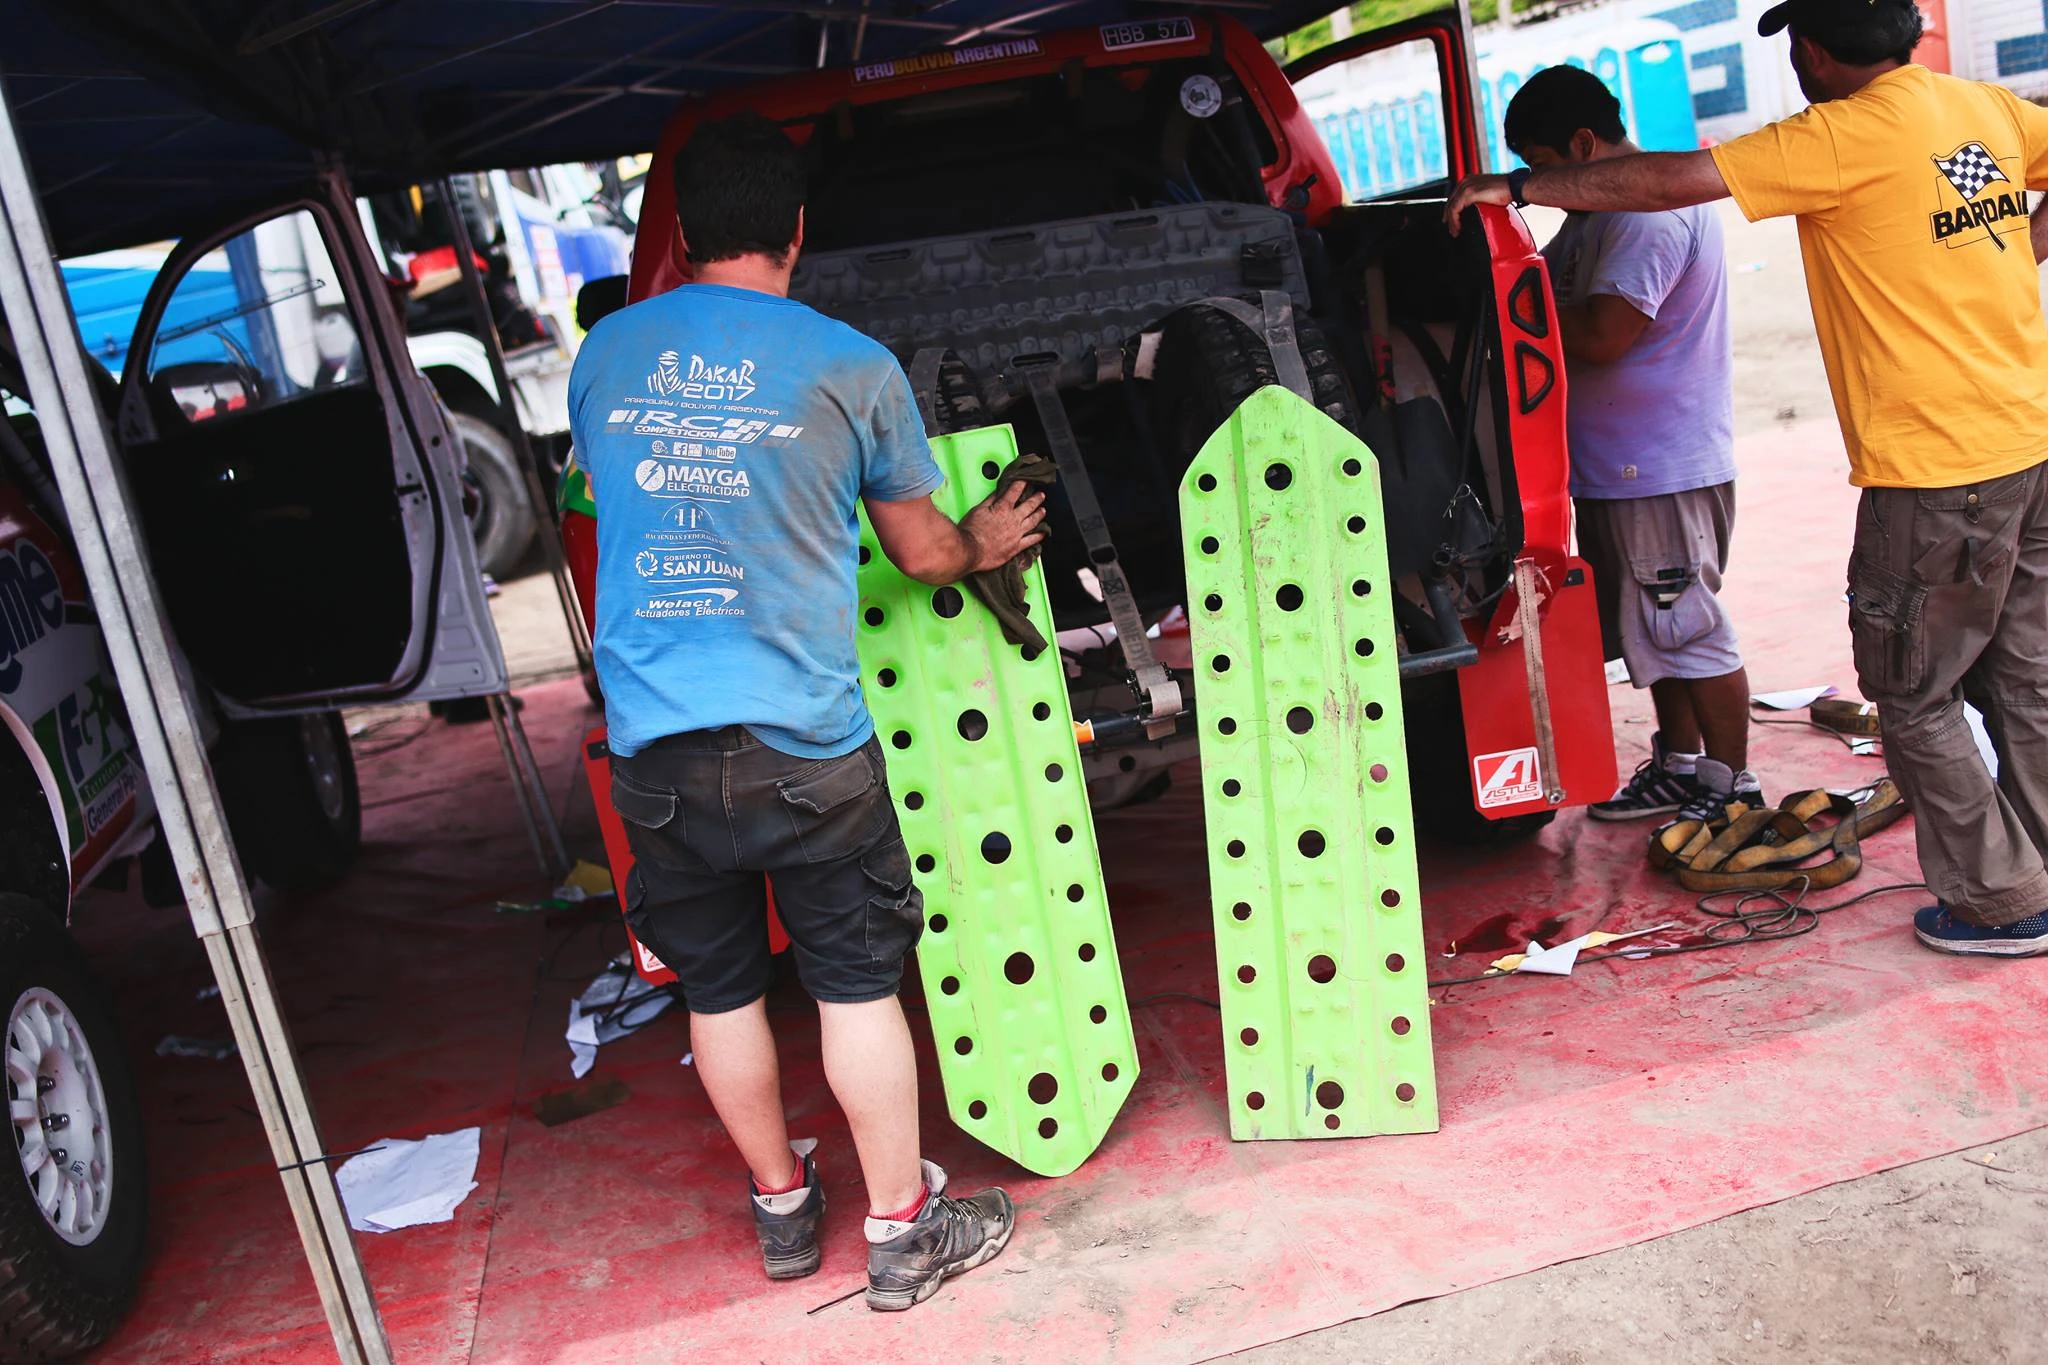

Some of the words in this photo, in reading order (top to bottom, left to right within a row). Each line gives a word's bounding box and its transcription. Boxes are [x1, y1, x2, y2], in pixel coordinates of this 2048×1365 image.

[1104, 26, 1145, 46] HBB
[1158, 20, 1191, 40] 571
[682, 383, 756, 401] 2017
[723, 405, 780, 417] ARGENTINA
[634, 425, 719, 439] COMPETICION
[667, 464, 751, 488] MAYGA
[667, 481, 751, 498] ELECTRICIDAD
[663, 561, 701, 577] SAN
[704, 561, 744, 580] JUAN
[648, 598, 713, 610] Welact
[635, 608, 690, 618] Actuadores
